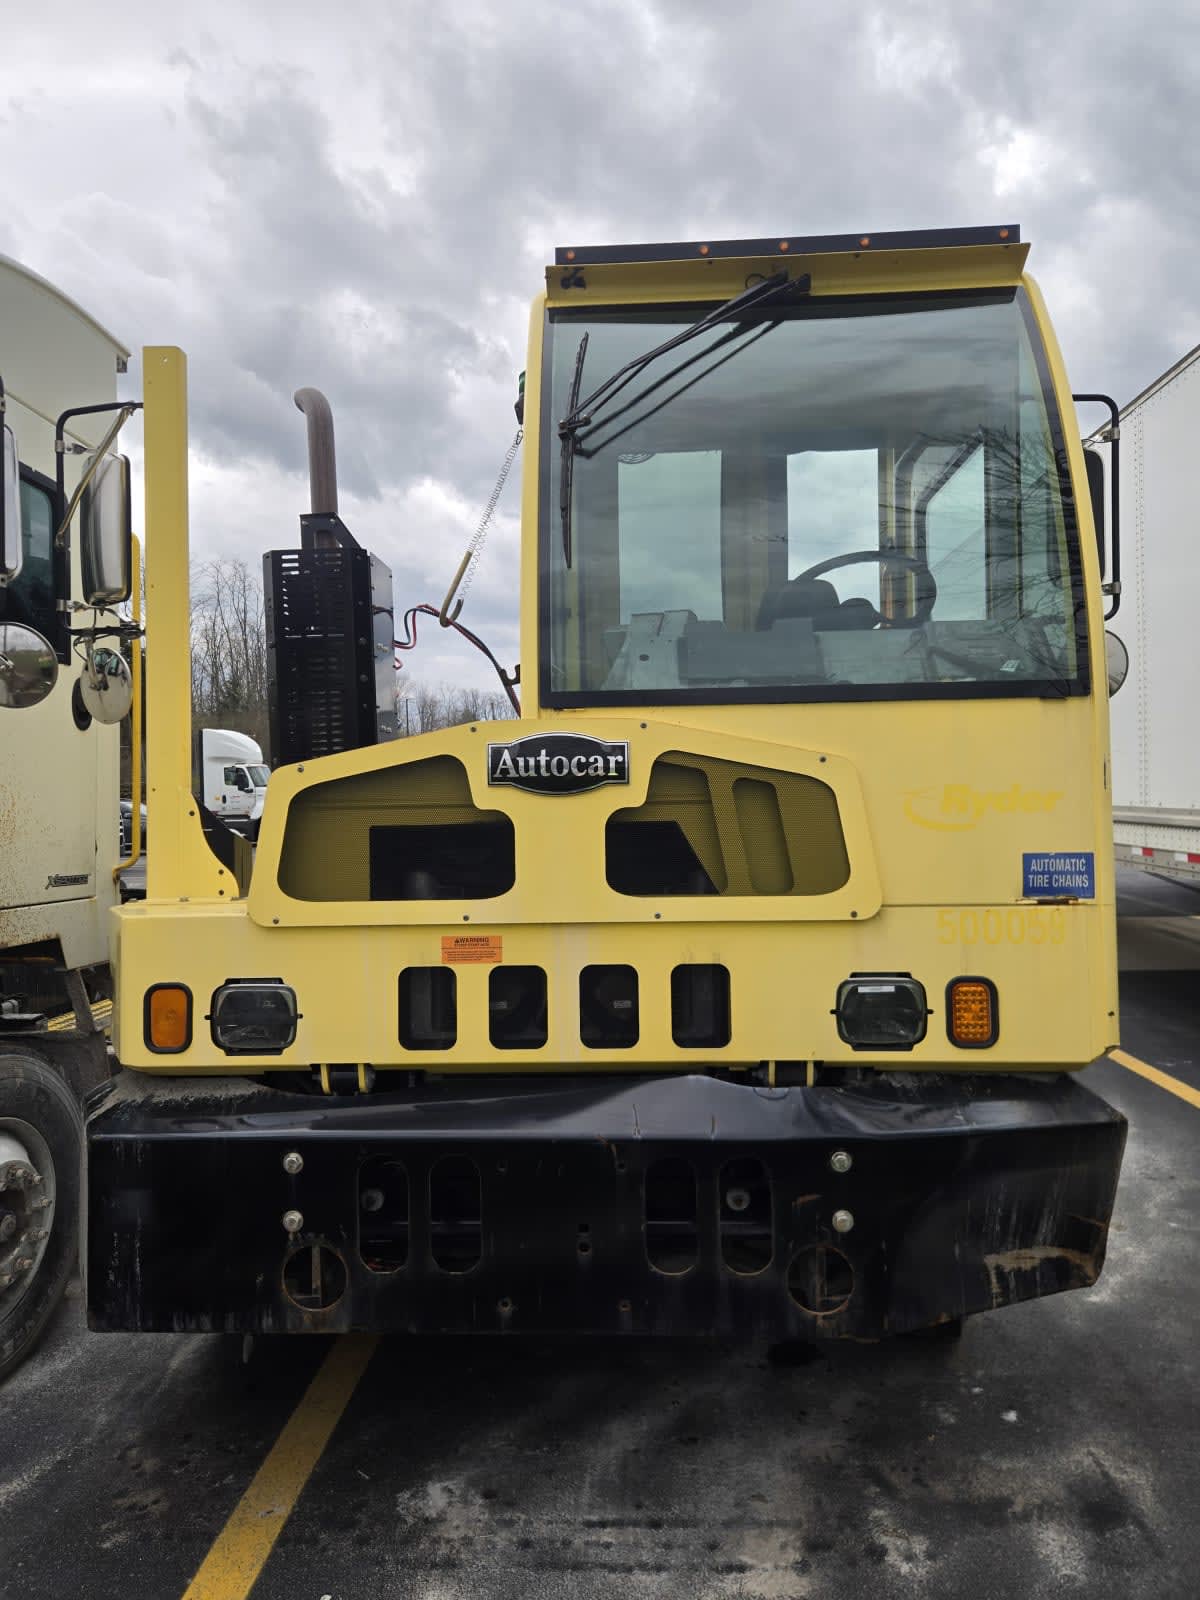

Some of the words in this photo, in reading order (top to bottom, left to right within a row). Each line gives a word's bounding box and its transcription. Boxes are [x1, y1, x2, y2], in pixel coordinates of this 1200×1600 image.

[493, 748, 624, 777] Autocar
[941, 783, 1065, 820] Ryder
[1030, 858, 1086, 872] AUTOMATIC
[1028, 874, 1050, 888] TIRE
[1052, 874, 1089, 888] CHAINS
[937, 908, 1066, 945] 500059
